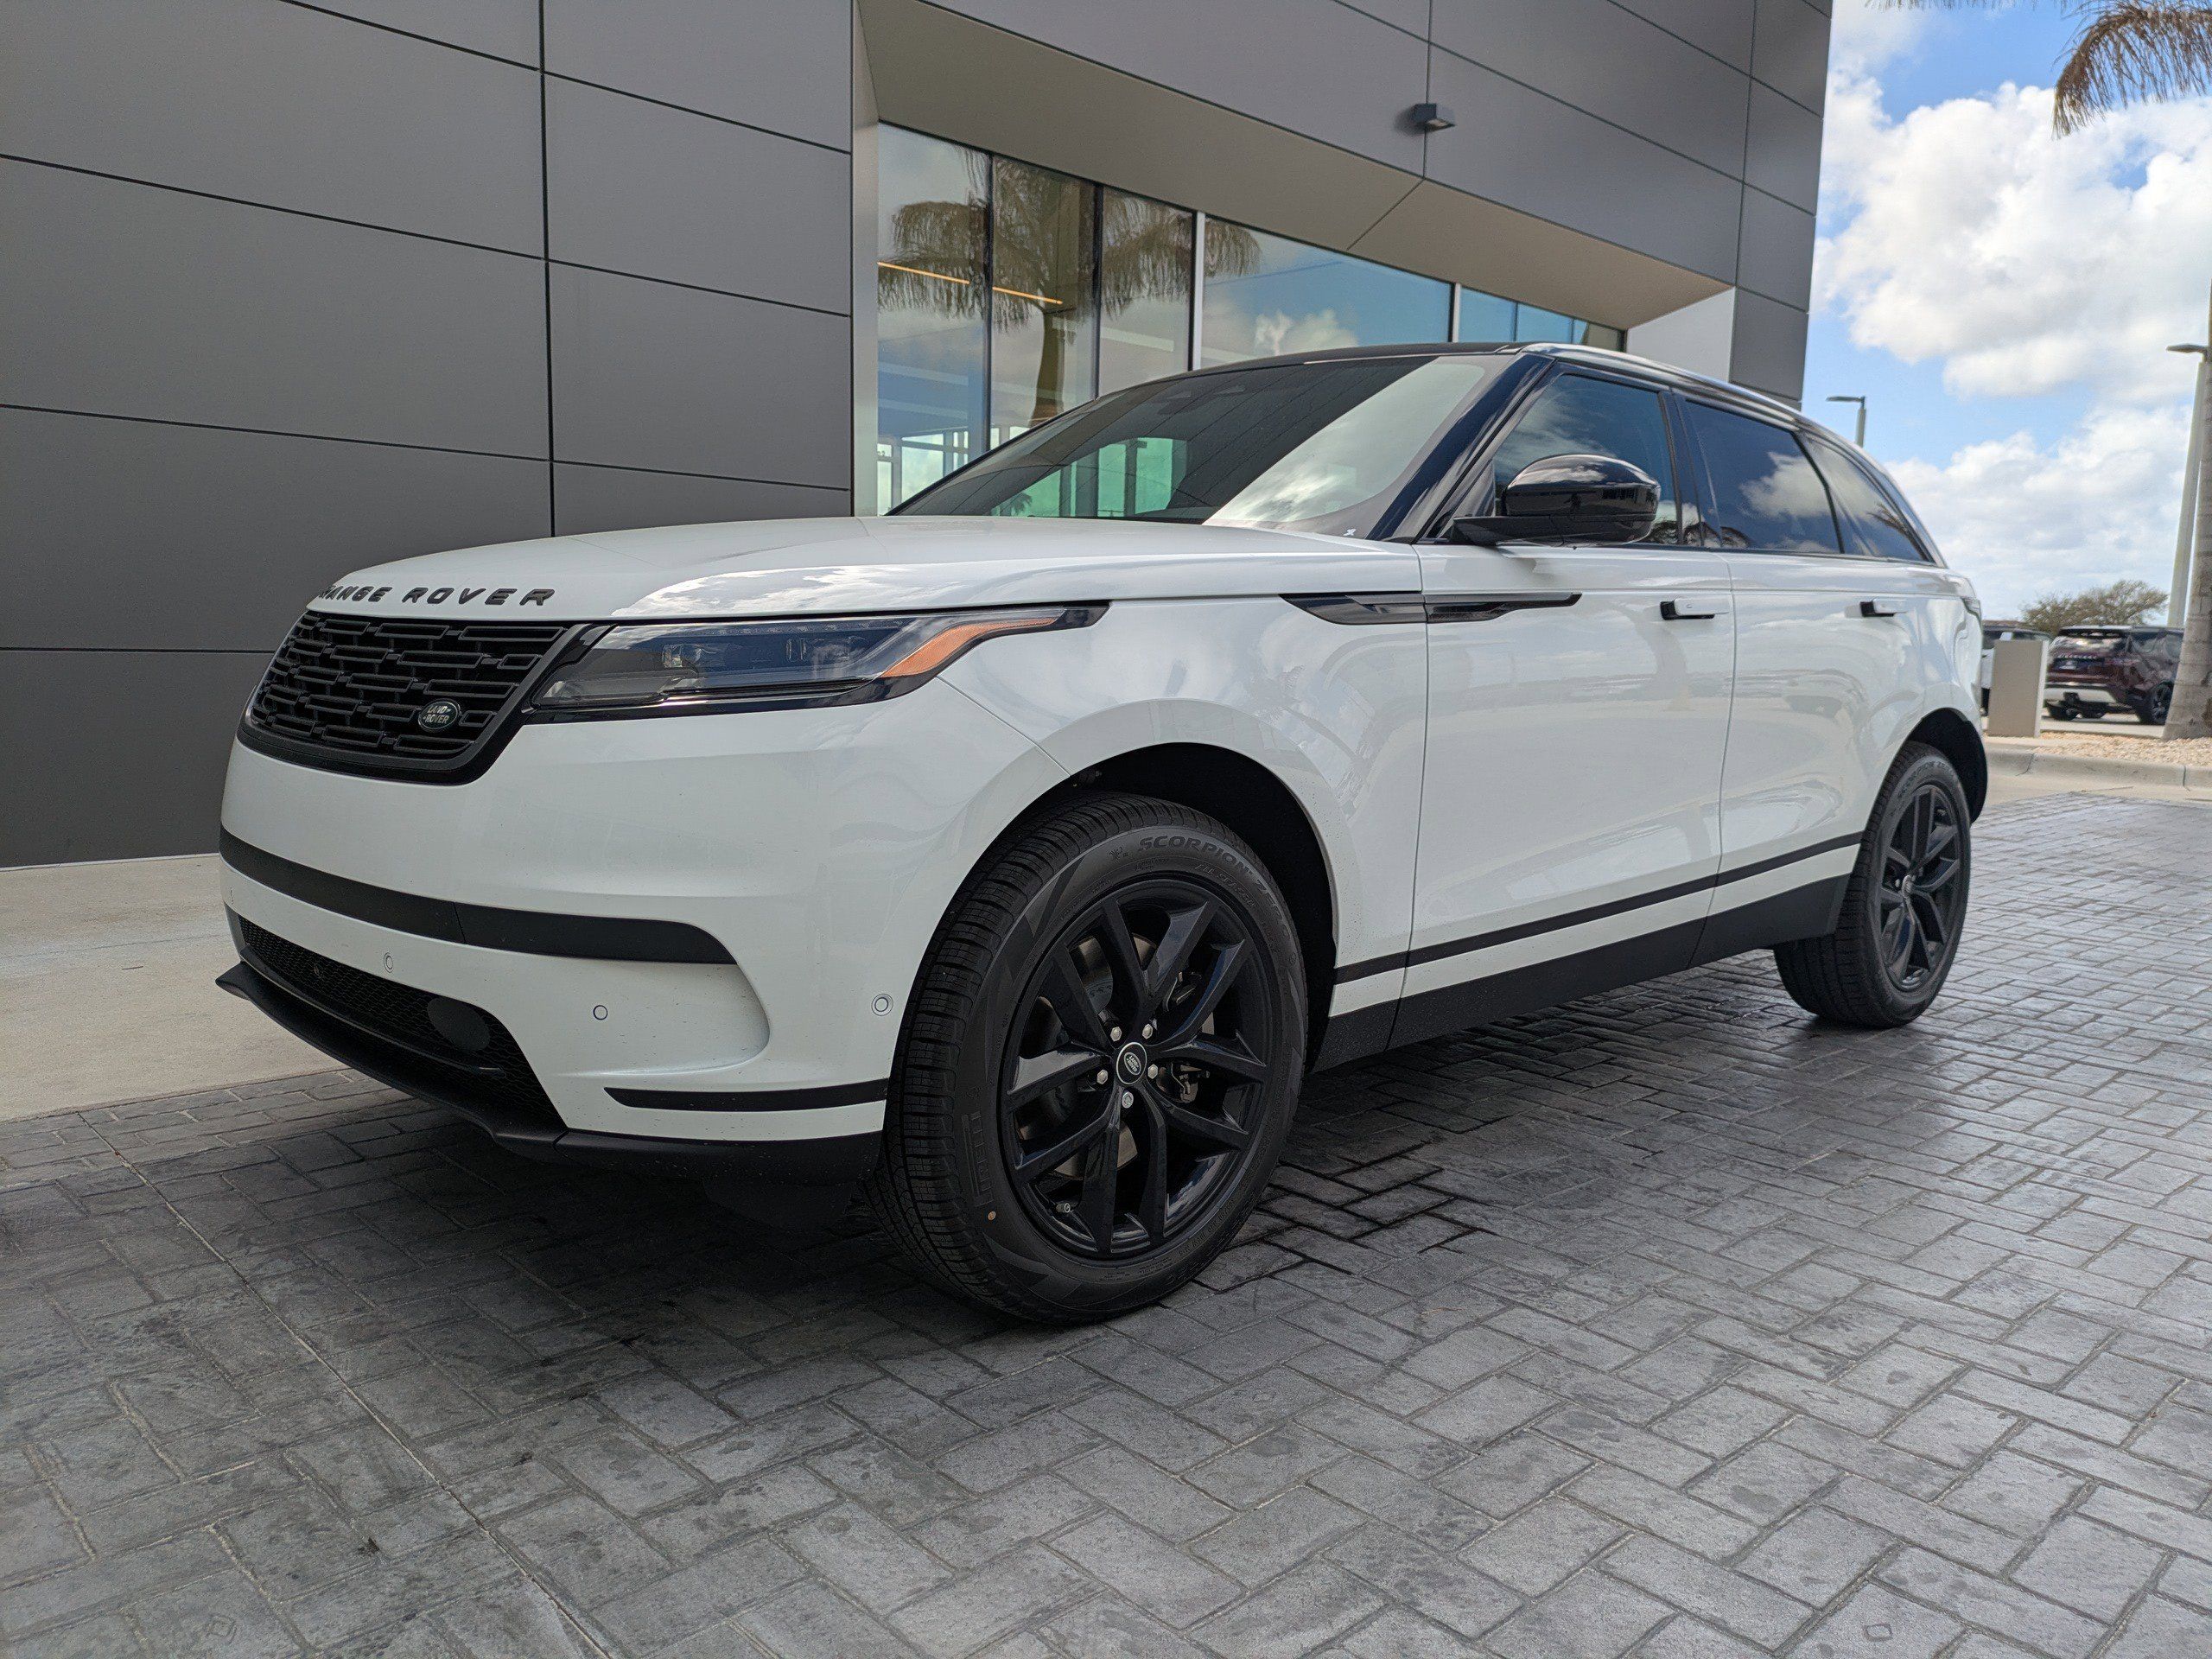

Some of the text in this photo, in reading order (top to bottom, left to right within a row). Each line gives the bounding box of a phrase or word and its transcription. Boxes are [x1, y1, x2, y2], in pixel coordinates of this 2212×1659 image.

[402, 587, 555, 606] ROVER
[424, 714, 449, 724] ROVER
[1138, 835, 1253, 875] SCORPION
